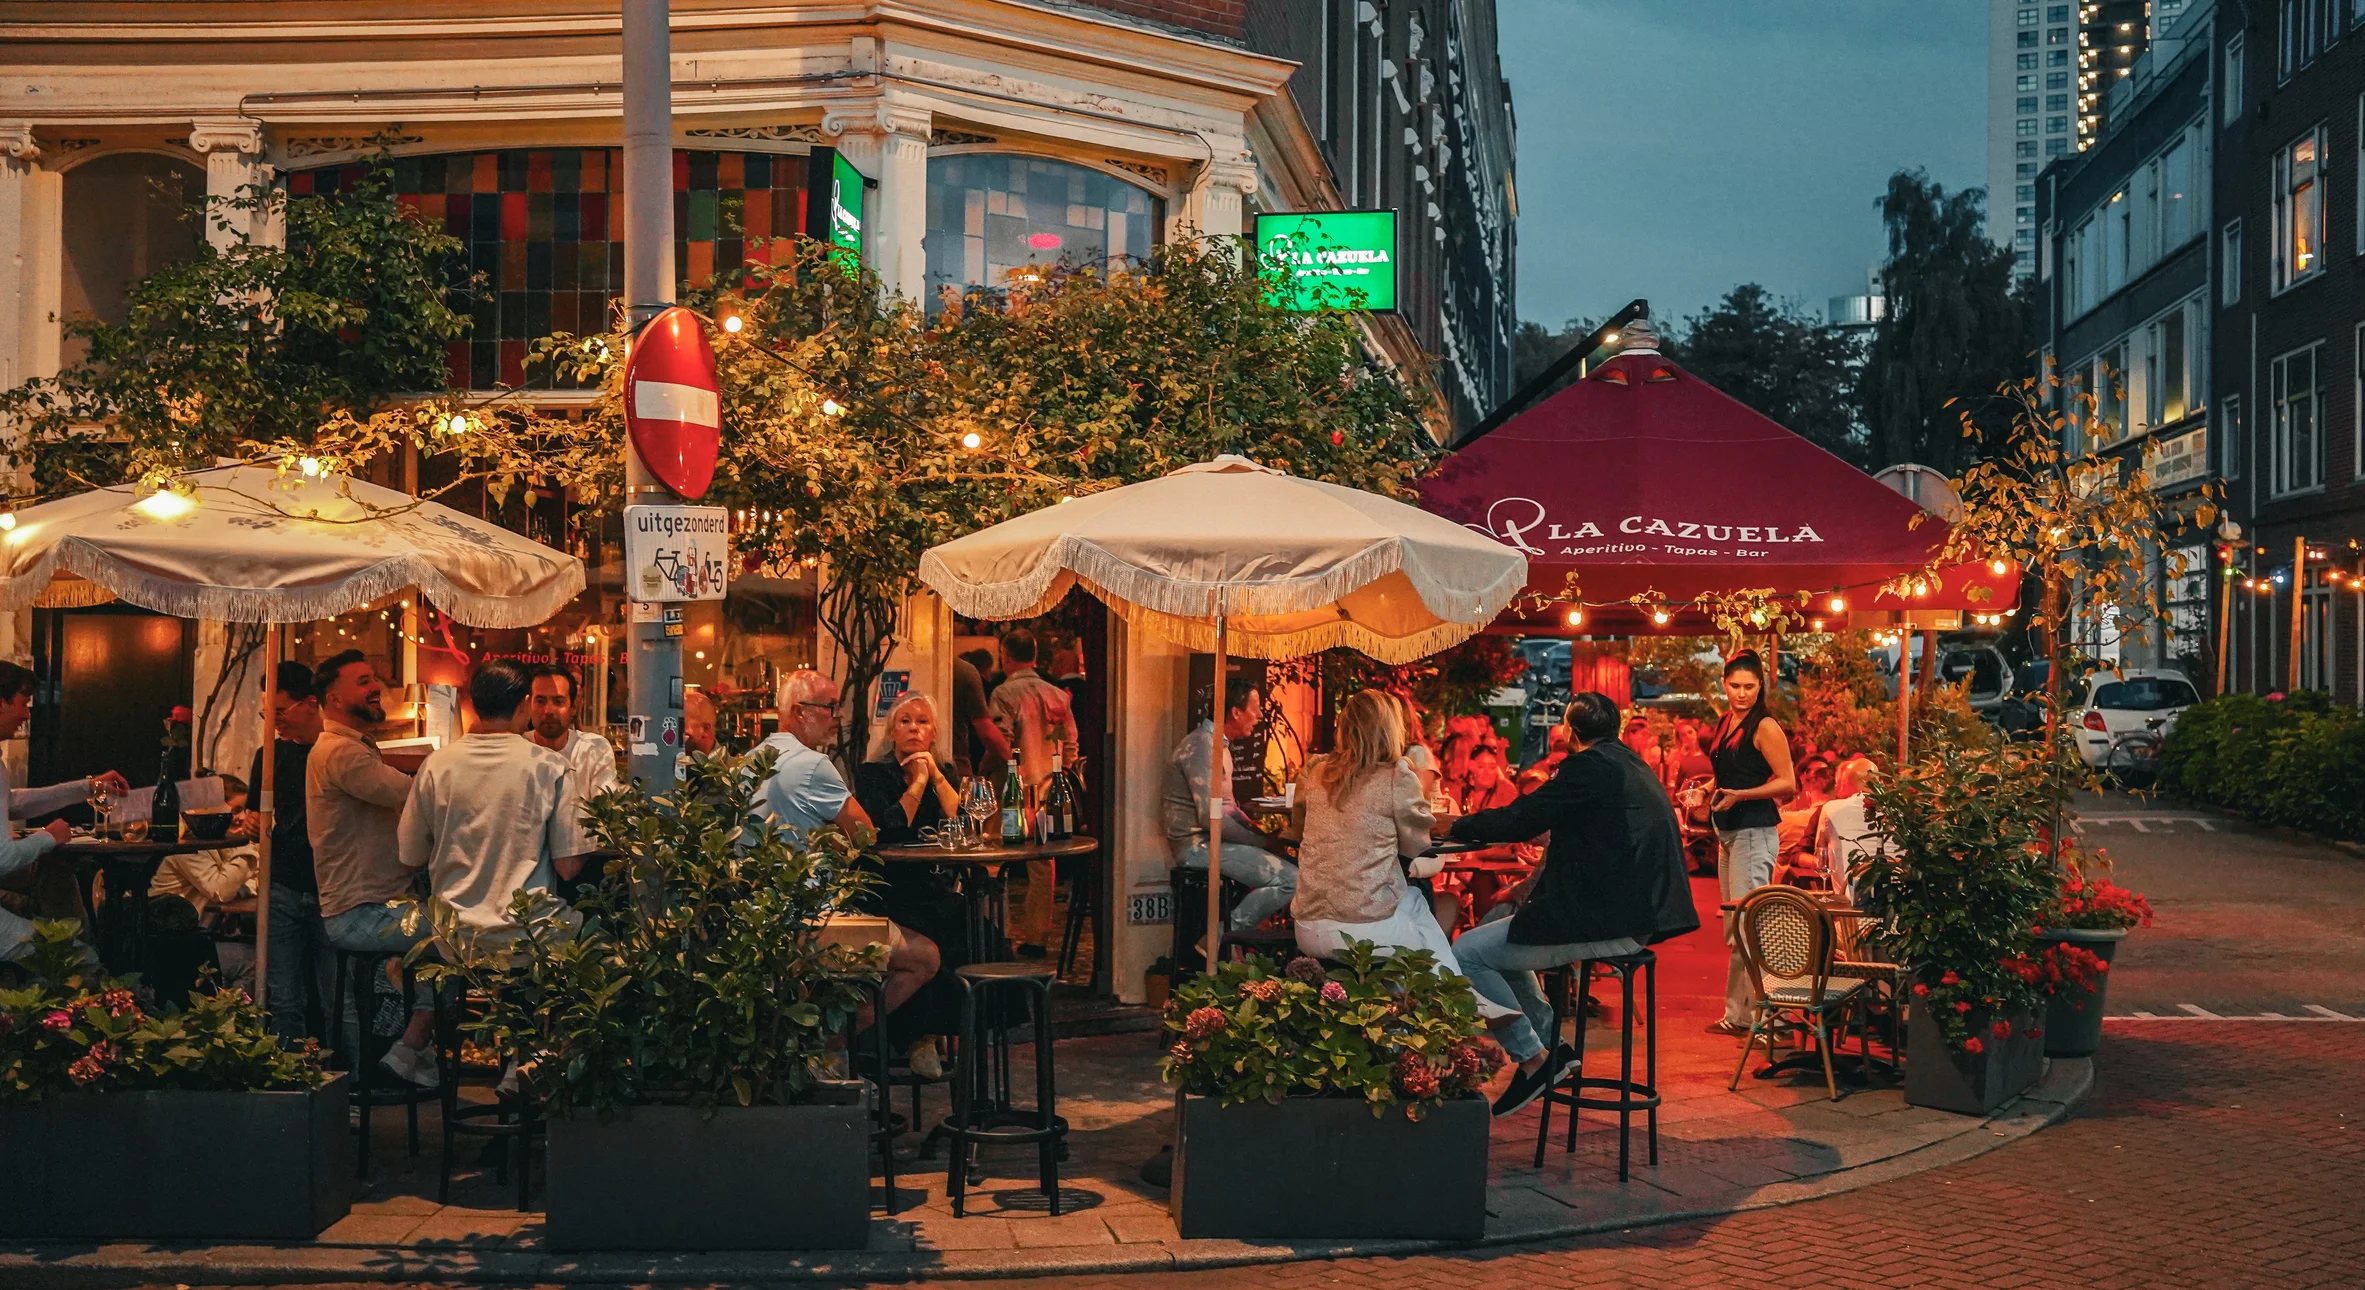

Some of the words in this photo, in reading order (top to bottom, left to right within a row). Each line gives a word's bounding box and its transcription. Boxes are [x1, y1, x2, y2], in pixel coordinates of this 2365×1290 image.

[1291, 251, 1313, 264] LA
[1316, 249, 1389, 264] CAZUELA
[638, 512, 725, 538] uitgezonderd
[1548, 522, 1604, 540] LA
[1619, 515, 1824, 543] CAZUELA
[1560, 543, 1646, 556] Aperitivo
[1664, 544, 1718, 557] Tapas
[1736, 549, 1769, 557] Bar
[481, 651, 549, 664] Aitivo
[564, 651, 606, 666] Tapas
[1133, 897, 1168, 920] 38B
